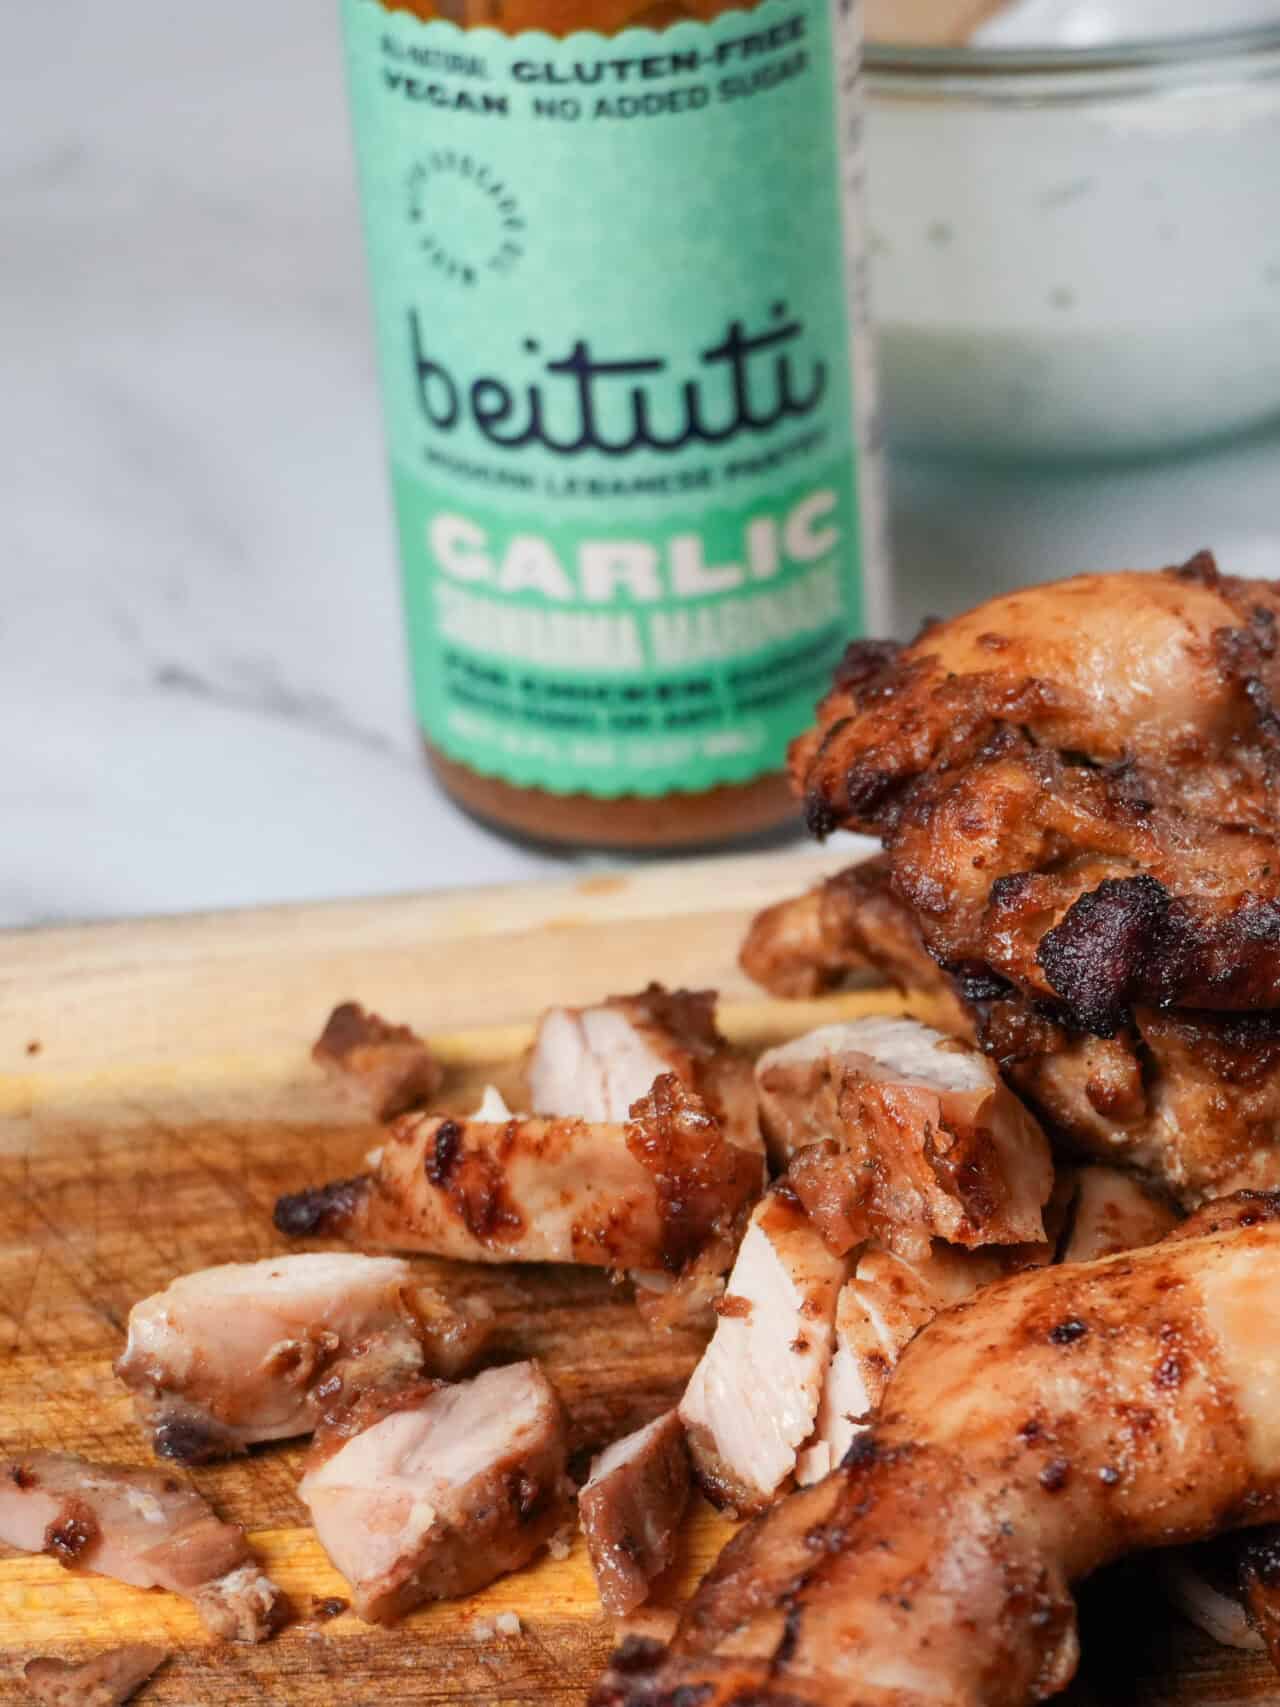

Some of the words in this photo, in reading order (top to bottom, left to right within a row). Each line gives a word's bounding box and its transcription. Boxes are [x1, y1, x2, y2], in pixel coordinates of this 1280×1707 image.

[511, 14, 807, 84] GLUTEN-FREE
[382, 67, 510, 119] VEGAN
[532, 97, 582, 121] NO
[594, 85, 711, 120] ADDED
[717, 50, 808, 104] SUGAR
[408, 302, 828, 456] beituti
[546, 465, 712, 496] LEBANESE
[428, 489, 840, 603] GARLIC
